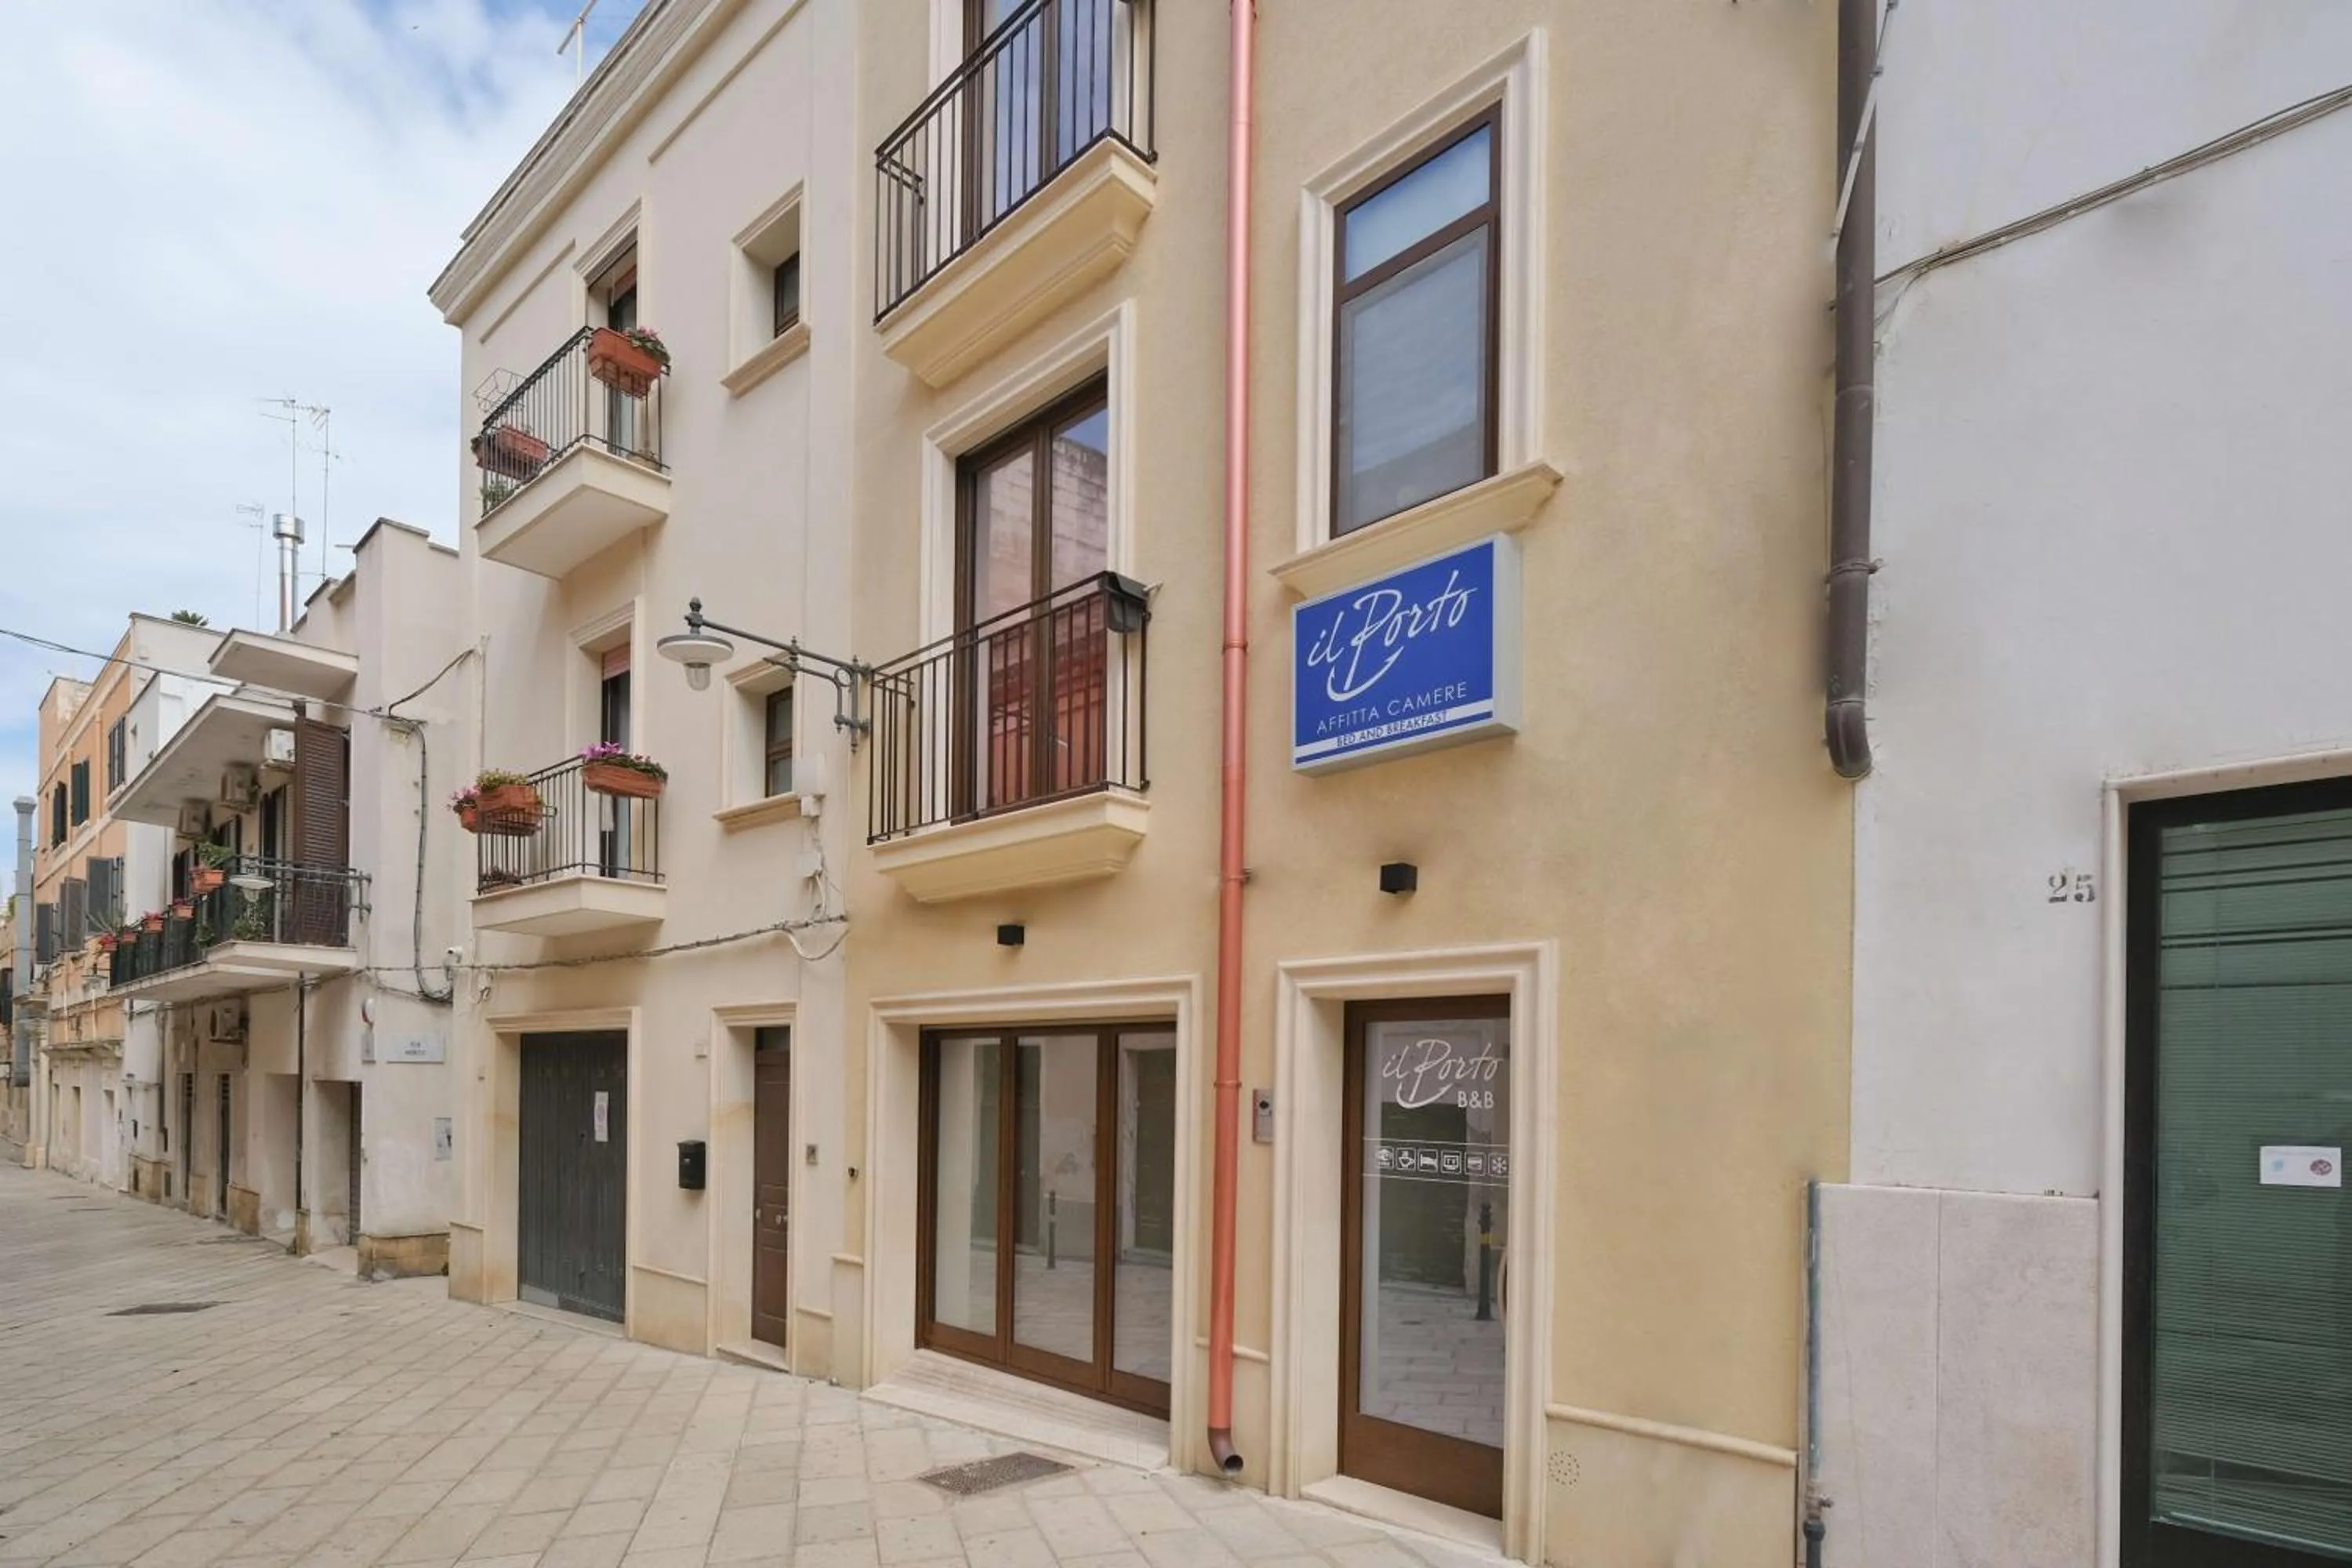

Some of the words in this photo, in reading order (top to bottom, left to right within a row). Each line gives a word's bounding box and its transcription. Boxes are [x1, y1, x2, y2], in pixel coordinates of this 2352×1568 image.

[1307, 612, 1343, 666] il
[1327, 570, 1478, 701] Porto
[1317, 706, 1379, 735] AFFITTA
[1387, 681, 1468, 717] CAMERE
[1337, 734, 1356, 747] BED
[1359, 726, 1384, 741] AND
[1387, 711, 1448, 735] BREAKFAST
[2048, 873, 2096, 903] 25
[1382, 1045, 1410, 1080] il
[1396, 1039, 1504, 1109] Porto
[1457, 1091, 1494, 1109] B&B
